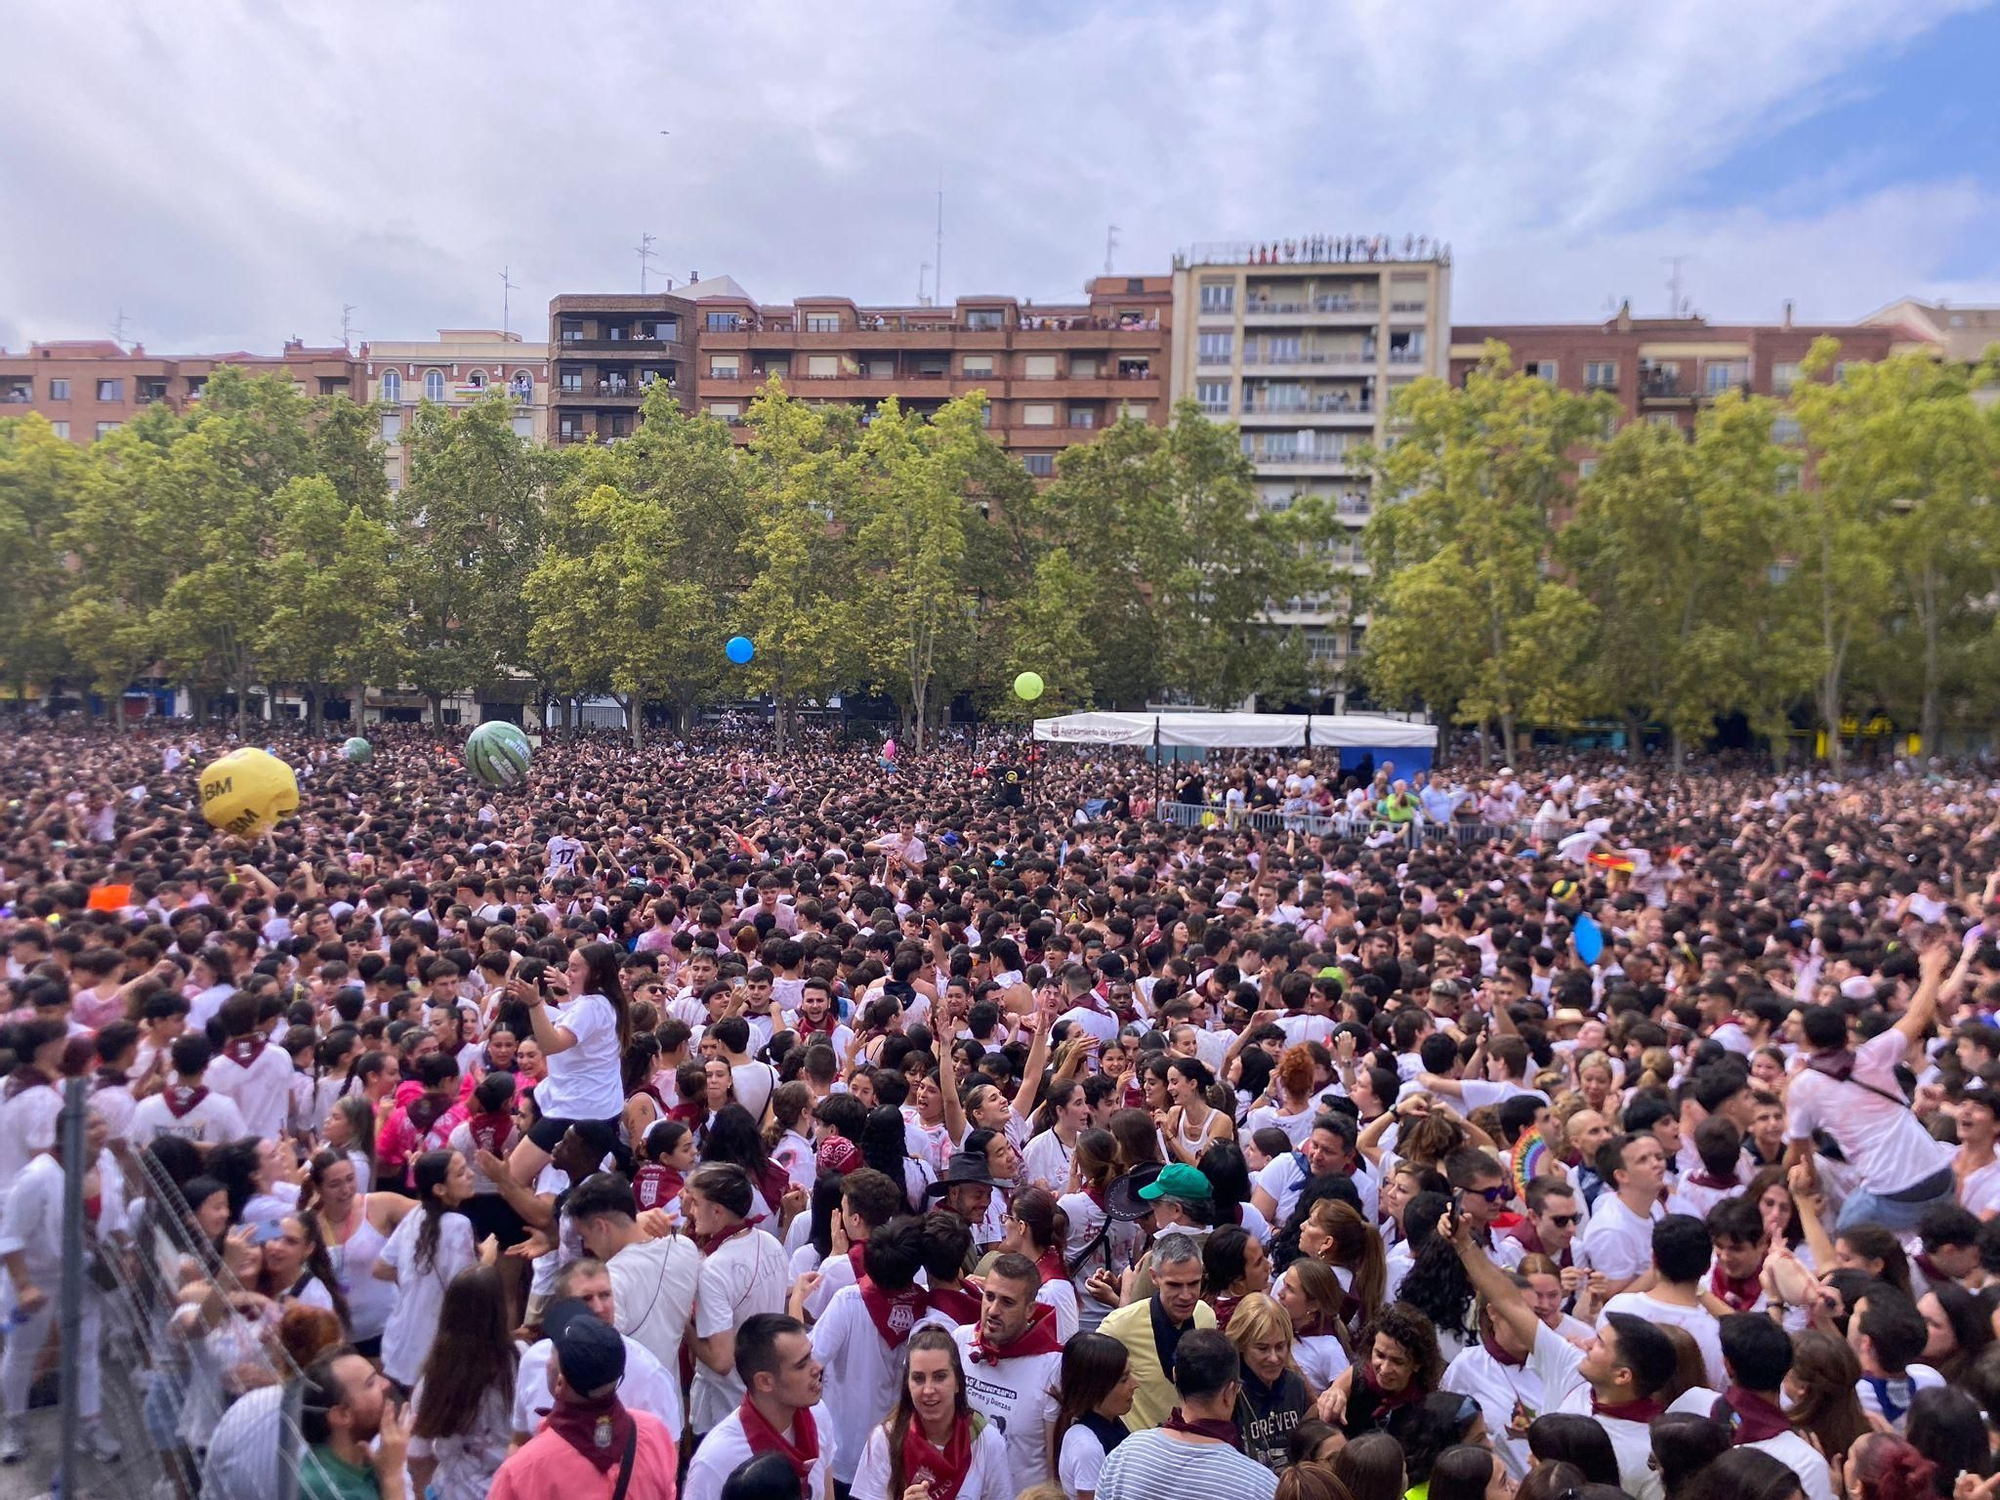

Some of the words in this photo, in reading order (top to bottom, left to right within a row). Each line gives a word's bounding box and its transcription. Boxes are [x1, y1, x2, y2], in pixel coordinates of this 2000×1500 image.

[1061, 727, 1099, 737] Ayuntamiento
[556, 849, 575, 865] 17
[974, 1380, 1016, 1399] Aniversario
[985, 1397, 990, 1405] y
[990, 1397, 1011, 1411] Danzas
[1250, 1410, 1299, 1440] OREVER
